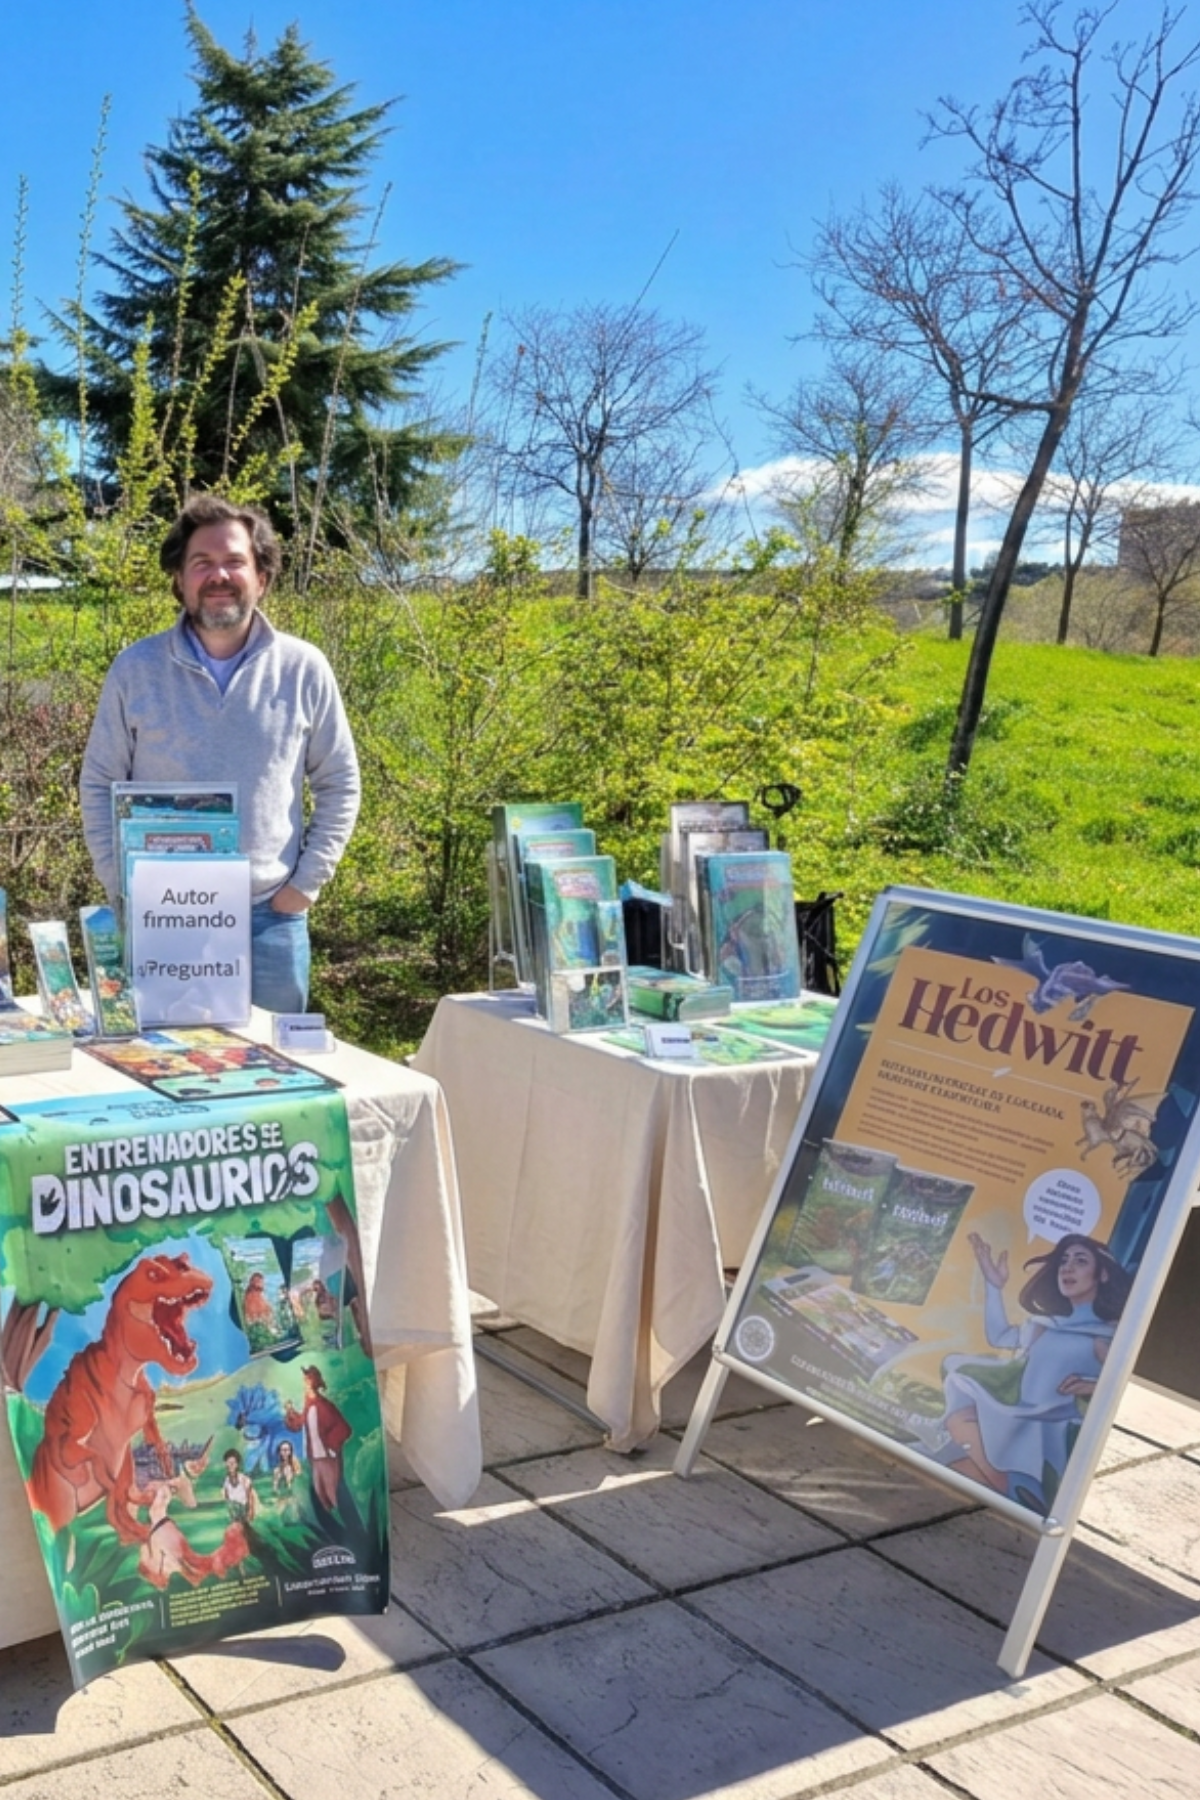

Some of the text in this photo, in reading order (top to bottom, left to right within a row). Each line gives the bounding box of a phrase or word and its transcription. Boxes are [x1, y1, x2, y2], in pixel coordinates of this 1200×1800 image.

[142, 910, 237, 929] firmando
[161, 888, 219, 905] Autor
[898, 976, 1144, 1087] Hedwitt
[65, 1122, 258, 1175] ENTRENADORES
[31, 1141, 320, 1235] DINOSAURIOS
